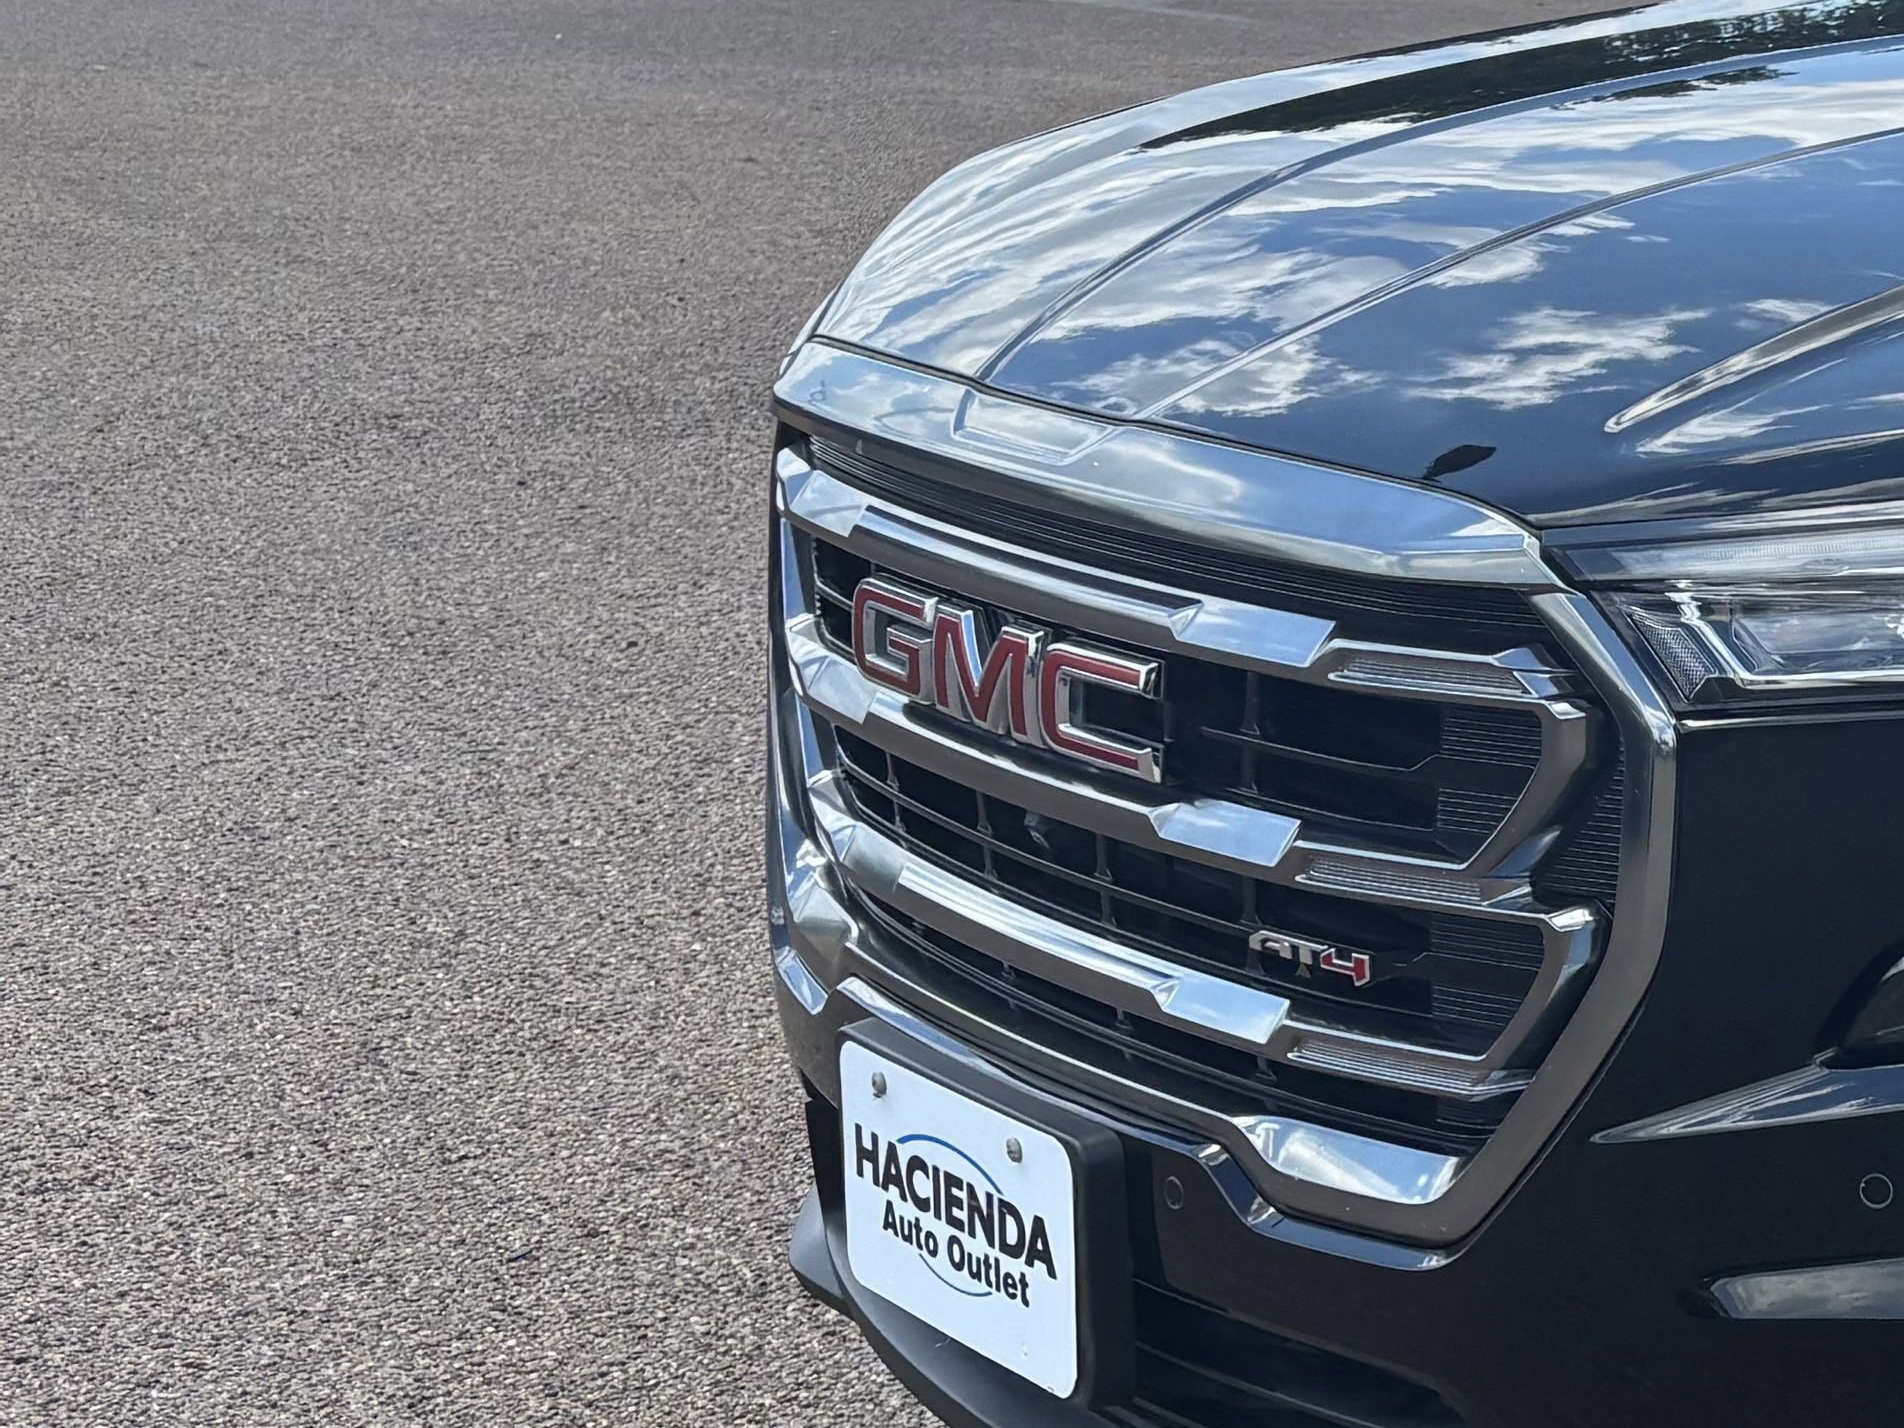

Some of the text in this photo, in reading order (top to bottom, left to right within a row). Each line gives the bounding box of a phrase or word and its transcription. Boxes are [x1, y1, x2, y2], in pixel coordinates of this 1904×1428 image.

[852, 578, 1164, 784] GMC
[1249, 930, 1370, 987] AT4
[854, 1123, 1057, 1280] HACIENDA
[882, 1200, 1030, 1308] Auto Outlet
